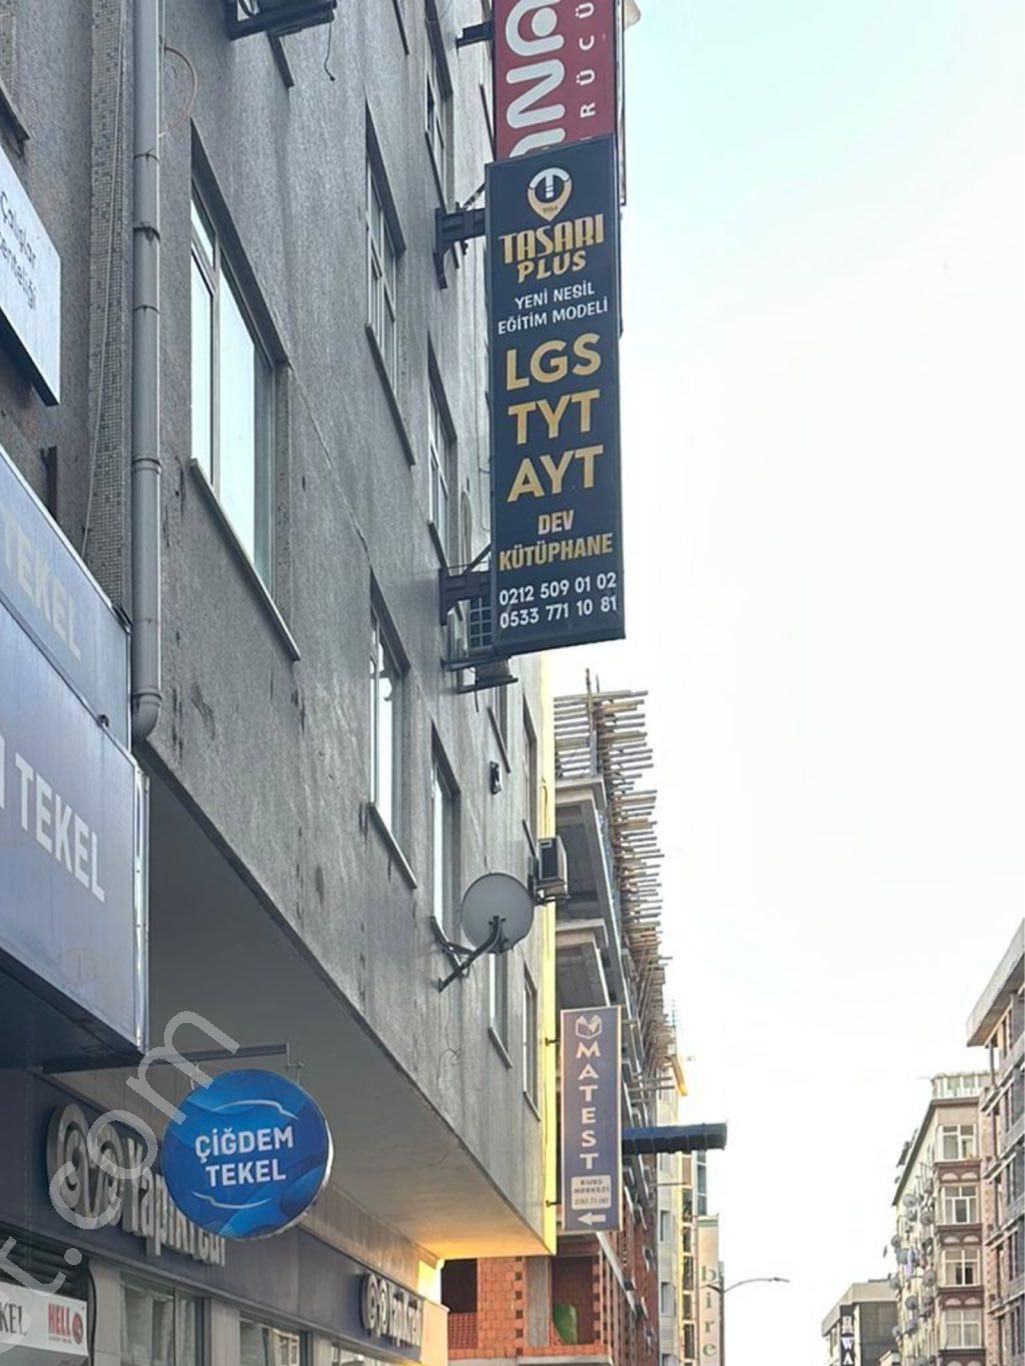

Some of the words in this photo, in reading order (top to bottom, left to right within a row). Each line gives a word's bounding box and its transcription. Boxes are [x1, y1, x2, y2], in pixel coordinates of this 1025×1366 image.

[577, 2, 596, 141] RÜCÜ
[498, 214, 604, 264] TASARI
[518, 251, 586, 283] PLUS
[515, 287, 548, 310] YENİ
[553, 281, 596, 303] NESİL
[498, 312, 548, 335] EĞİTİM
[553, 299, 609, 322] MODELİ
[506, 333, 601, 391] LGS
[508, 389, 600, 445] TYT
[507, 445, 604, 502] AYT
[538, 510, 574, 535] DEV
[499, 533, 613, 571] KÜTÜPHANE
[0, 500, 82, 661] TEKEL
[499, 586, 535, 606] 0212
[540, 579, 569, 599] 509
[574, 575, 591, 592] 01
[596, 572, 617, 590] 02
[499, 610, 539, 629] 0533
[545, 603, 569, 621] 771
[576, 598, 593, 616] 10
[600, 596, 617, 613] 81
[14, 752, 106, 903] TEKEL
[576, 1041, 601, 1170] MATEST
[194, 1124, 294, 1164] ÇİĞDEM
[205, 1160, 287, 1188] TEKEL
[48, 1302, 72, 1337] HELL
